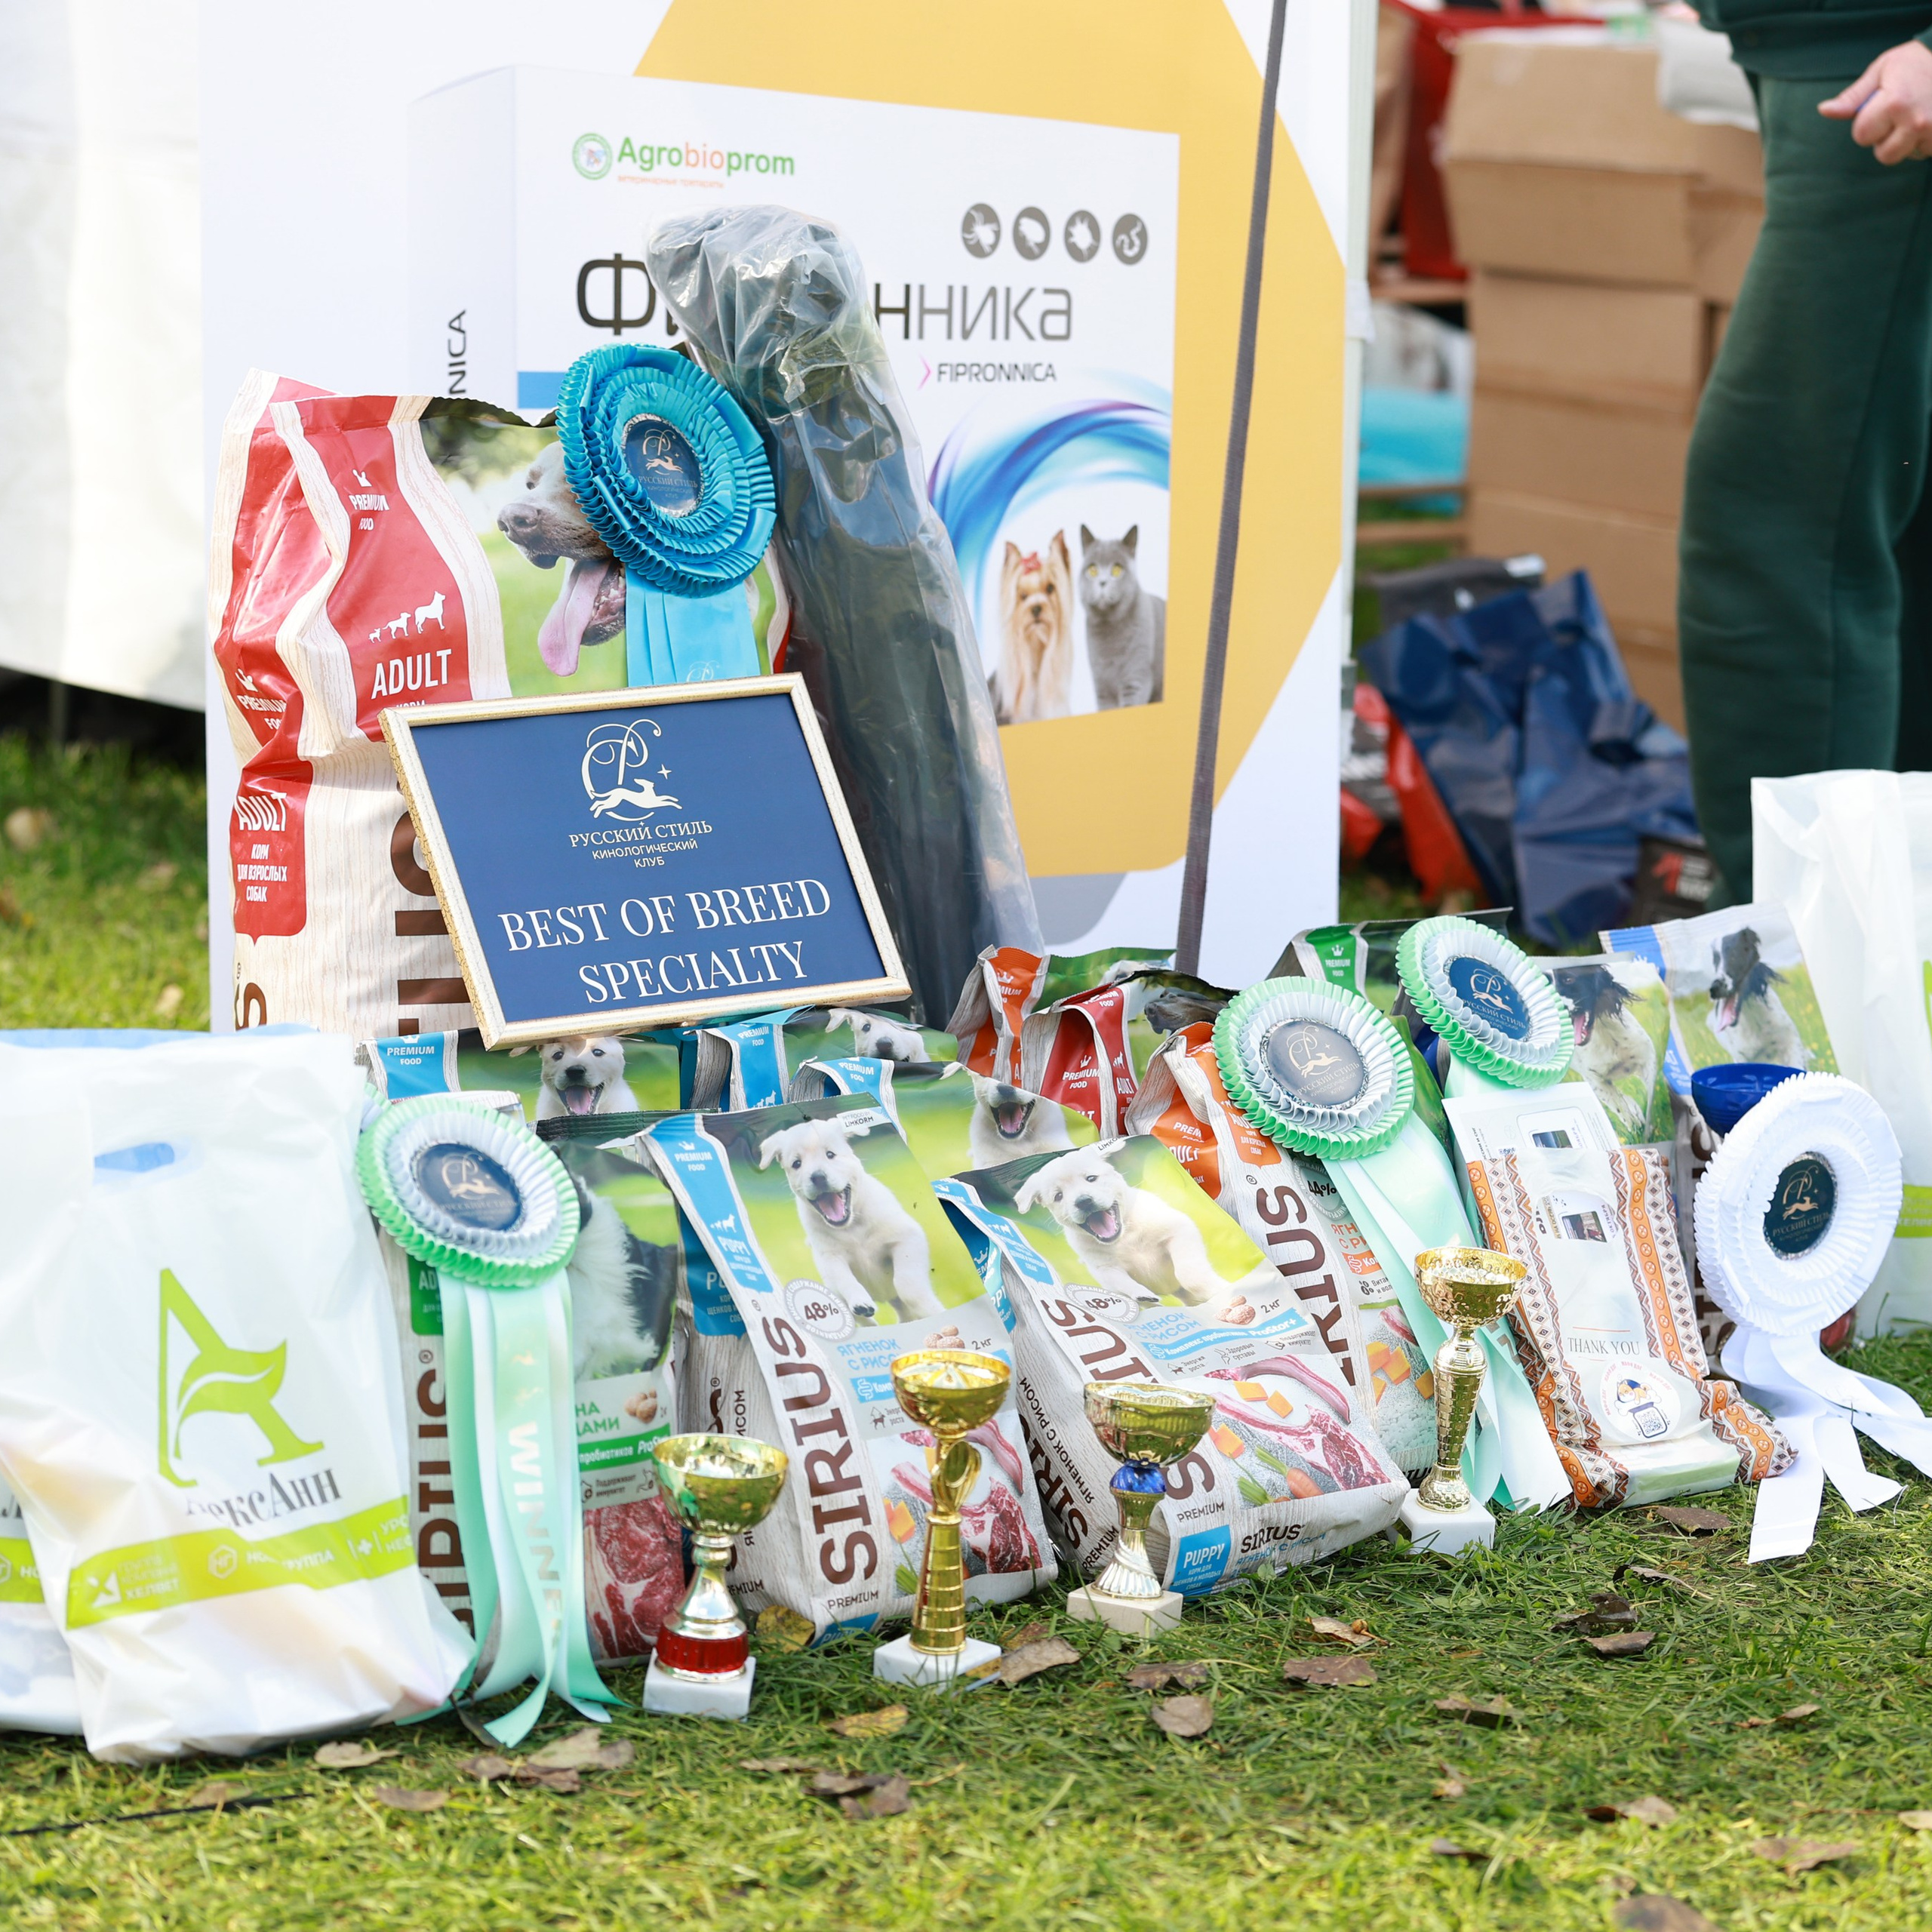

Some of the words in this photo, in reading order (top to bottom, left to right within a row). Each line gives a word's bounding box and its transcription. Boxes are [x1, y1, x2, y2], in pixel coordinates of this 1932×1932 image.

[617, 137, 795, 177] Agrobioprom
[448, 309, 467, 395] NICA
[937, 363, 1057, 382] FIPRONNICA
[349, 494, 389, 511] PREMIUM
[371, 648, 452, 700] ADULT
[236, 695, 287, 712] PREMIUM
[234, 792, 287, 832] ADULT
[568, 821, 653, 848] РУССКИЙ
[655, 820, 713, 838] СТИЛЬ
[251, 844, 269, 860] КОРМ
[592, 838, 698, 860] КИНОЛОГИЧЕСКИЙ
[634, 856, 665, 868] КЛУБ
[248, 865, 288, 881] ВЗРОСЛЫХ
[246, 886, 268, 902] СОБАК
[498, 901, 609, 952] BEST
[620, 895, 677, 937] OF
[685, 878, 831, 931] BREED
[1325, 958, 1350, 967] PREMIUM
[579, 940, 809, 1004] SPECIALTY
[1500, 1014, 1526, 1029] СТИЛЬ
[738, 1026, 769, 1039] PREMIUM
[752, 1038, 764, 1047] FOOD
[386, 1046, 435, 1057] PREMIUM
[400, 1057, 422, 1066] FOOD
[839, 1062, 874, 1075] PREMIUM
[851, 1073, 864, 1083] FOOD
[1062, 1069, 1100, 1081] PREMIUM
[1297, 1075, 1334, 1095] РУССКИЙ
[1334, 1062, 1360, 1077] СТИЛЬ
[844, 1116, 874, 1128] LIMKORM
[1173, 1122, 1201, 1137] PREM
[1098, 1137, 1118, 1151] LIMKO
[675, 1152, 712, 1162] PREMIUM
[1169, 1146, 1200, 1164] DULT
[1307, 1180, 1337, 1197] 44%
[719, 1294, 731, 1303] КОР
[1084, 1297, 1121, 1310] 48%
[804, 1302, 839, 1321] 48%
[1260, 1305, 1270, 1314] 2
[730, 1314, 743, 1323] СОБ
[1164, 1337, 1204, 1355] Комплекс
[1248, 1318, 1297, 1336] ProStor+
[837, 1339, 901, 1356] ЯГНЕНОК
[971, 1340, 980, 1350] 2
[1226, 1343, 1255, 1353] Здоровые
[1567, 1337, 1608, 1355] THANK
[1611, 1340, 1641, 1355] YOU
[1181, 1355, 1205, 1367] Энергия
[1232, 1350, 1256, 1361] суставы
[848, 1359, 860, 1370] С
[1188, 1364, 1205, 1373] роста
[1020, 1377, 1050, 1428] РИСОМ
[1046, 1429, 1055, 1440] С
[762, 1315, 878, 1586] SIRIUS
[1053, 1440, 1094, 1504] ЯГНЕНОК
[1177, 1501, 1225, 1522] PREMIUM
[1241, 1524, 1301, 1554] SIRIUS
[1081, 1525, 1119, 1571] PREMIUM
[1183, 1543, 1225, 1568] PUPPY
[1201, 1564, 1212, 1573] ДЛЯ
[727, 1579, 764, 1596] REMIUM
[827, 1590, 878, 1609] PREMIUM
